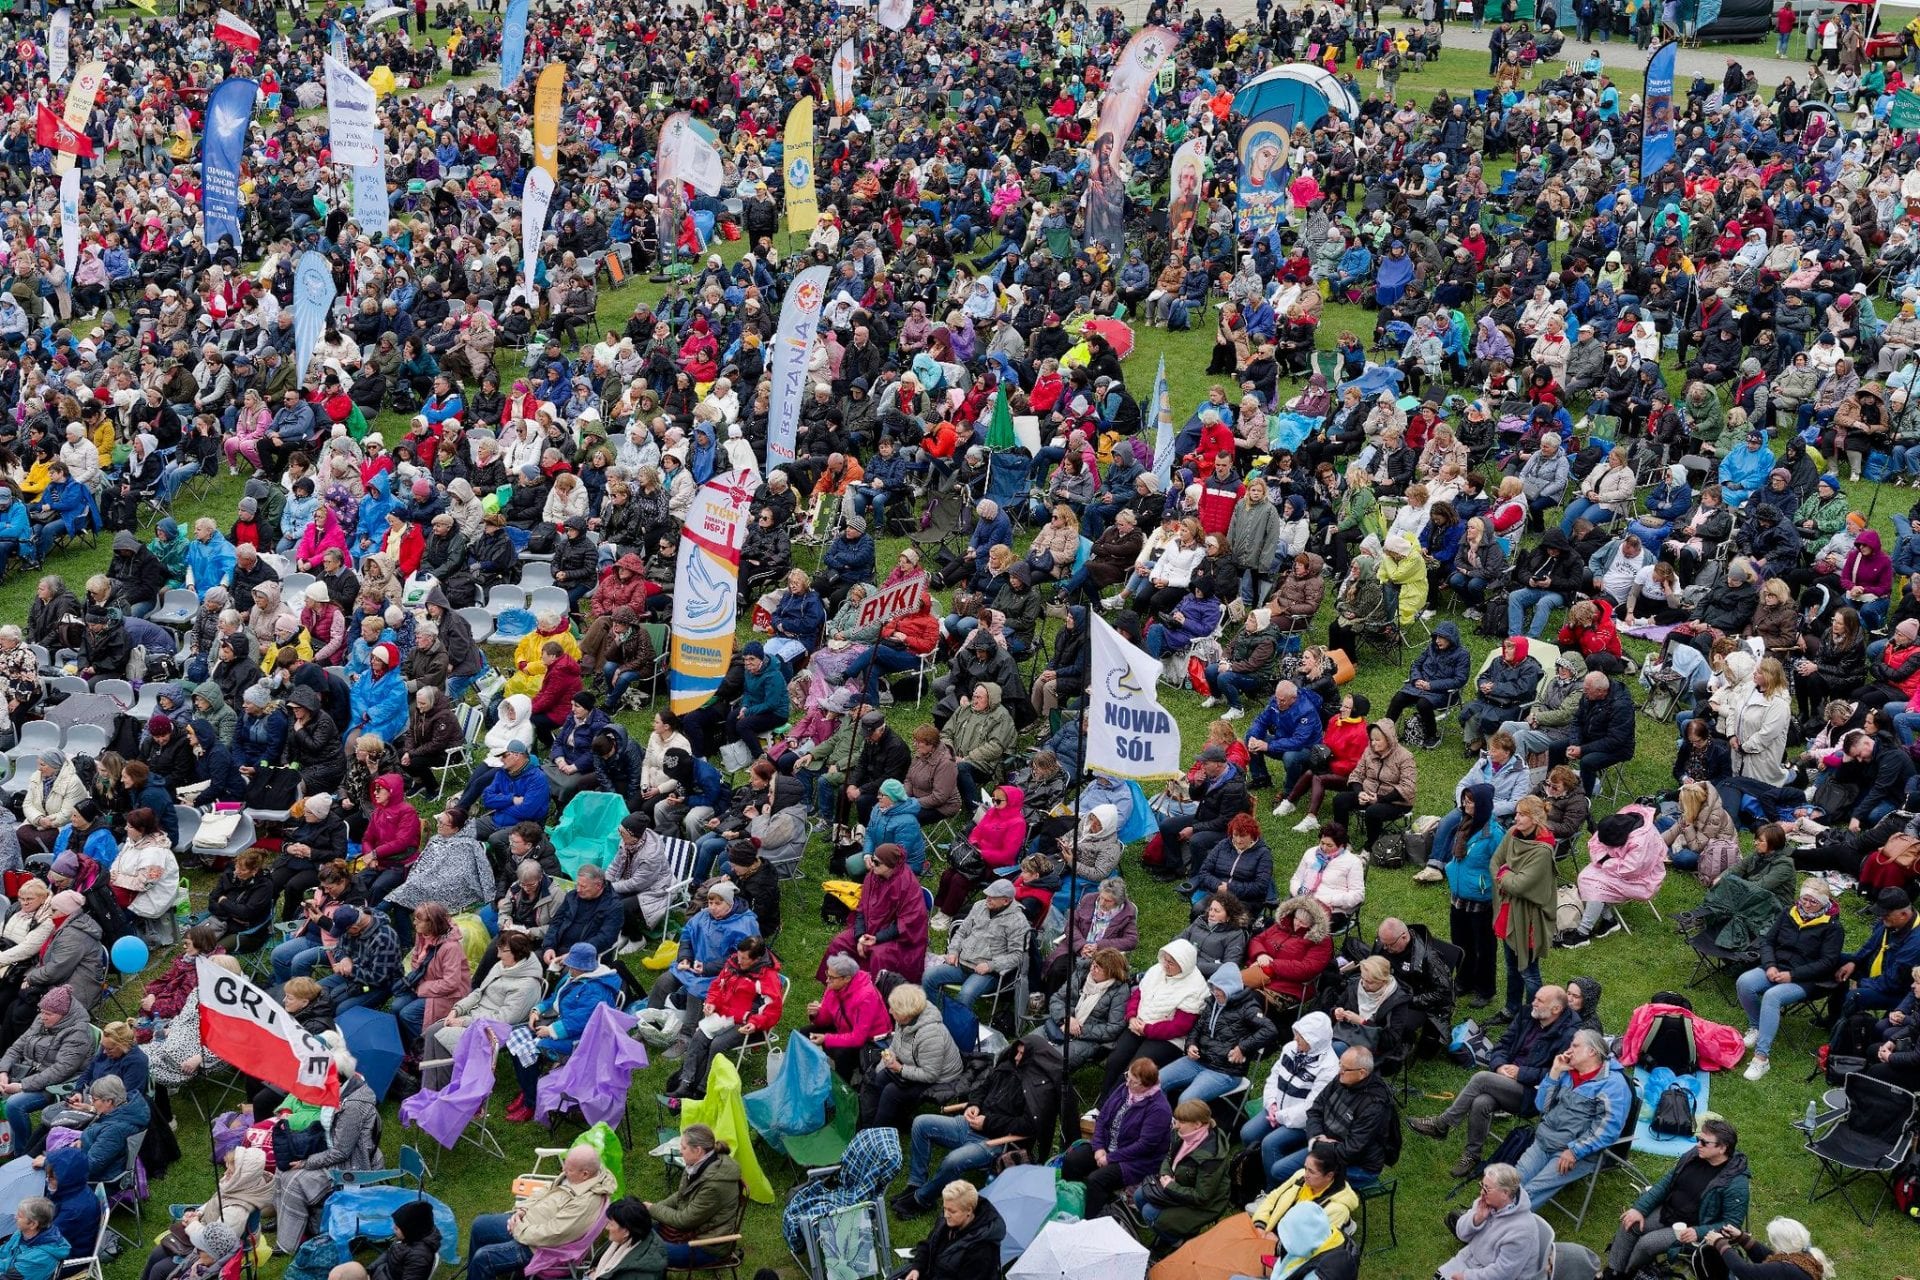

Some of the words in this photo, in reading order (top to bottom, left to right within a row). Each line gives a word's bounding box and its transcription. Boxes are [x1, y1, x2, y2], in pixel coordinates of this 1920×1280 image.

[705, 503, 740, 523] TYCHY
[704, 521, 726, 535] NSPJ
[860, 583, 919, 626] RYKI
[681, 643, 722, 657] ODNOWA
[1105, 702, 1170, 734] NOWA
[1116, 736, 1154, 762] SÓL
